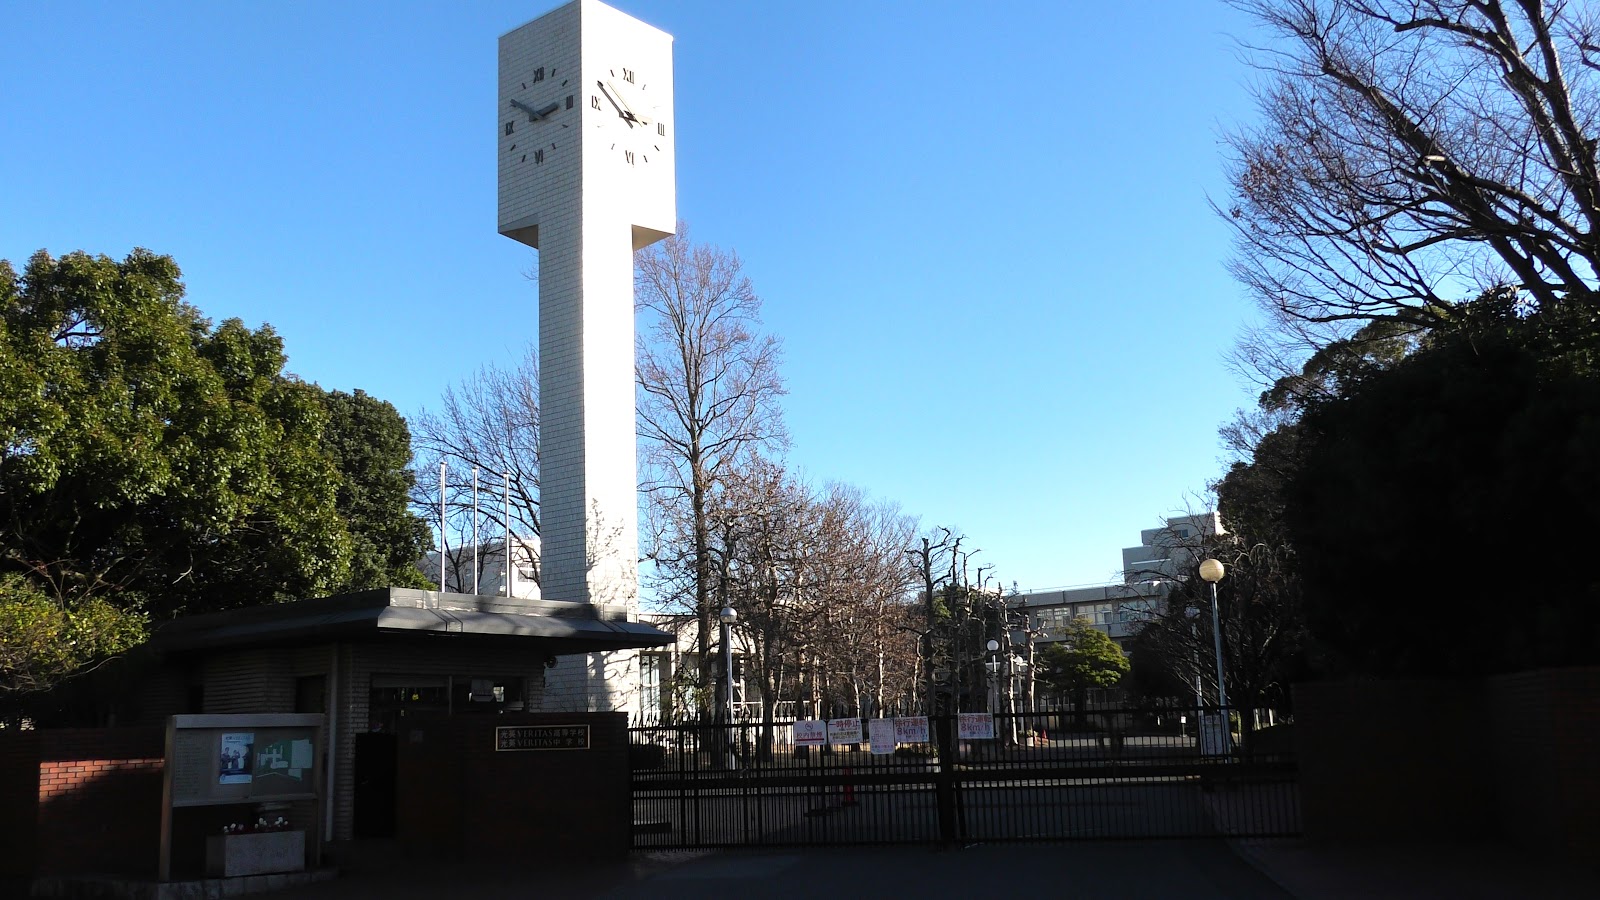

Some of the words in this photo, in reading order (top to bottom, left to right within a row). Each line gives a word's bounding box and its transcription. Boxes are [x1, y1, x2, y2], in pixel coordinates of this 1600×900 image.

[591, 95, 602, 111] IX
[505, 120, 515, 136] IX
[657, 122, 666, 137] III
[534, 148, 544, 165] VI
[625, 149, 635, 168] VI
[828, 719, 860, 728] 一時停止
[897, 727, 926, 735] 8km/h
[961, 723, 991, 731] 8km/h
